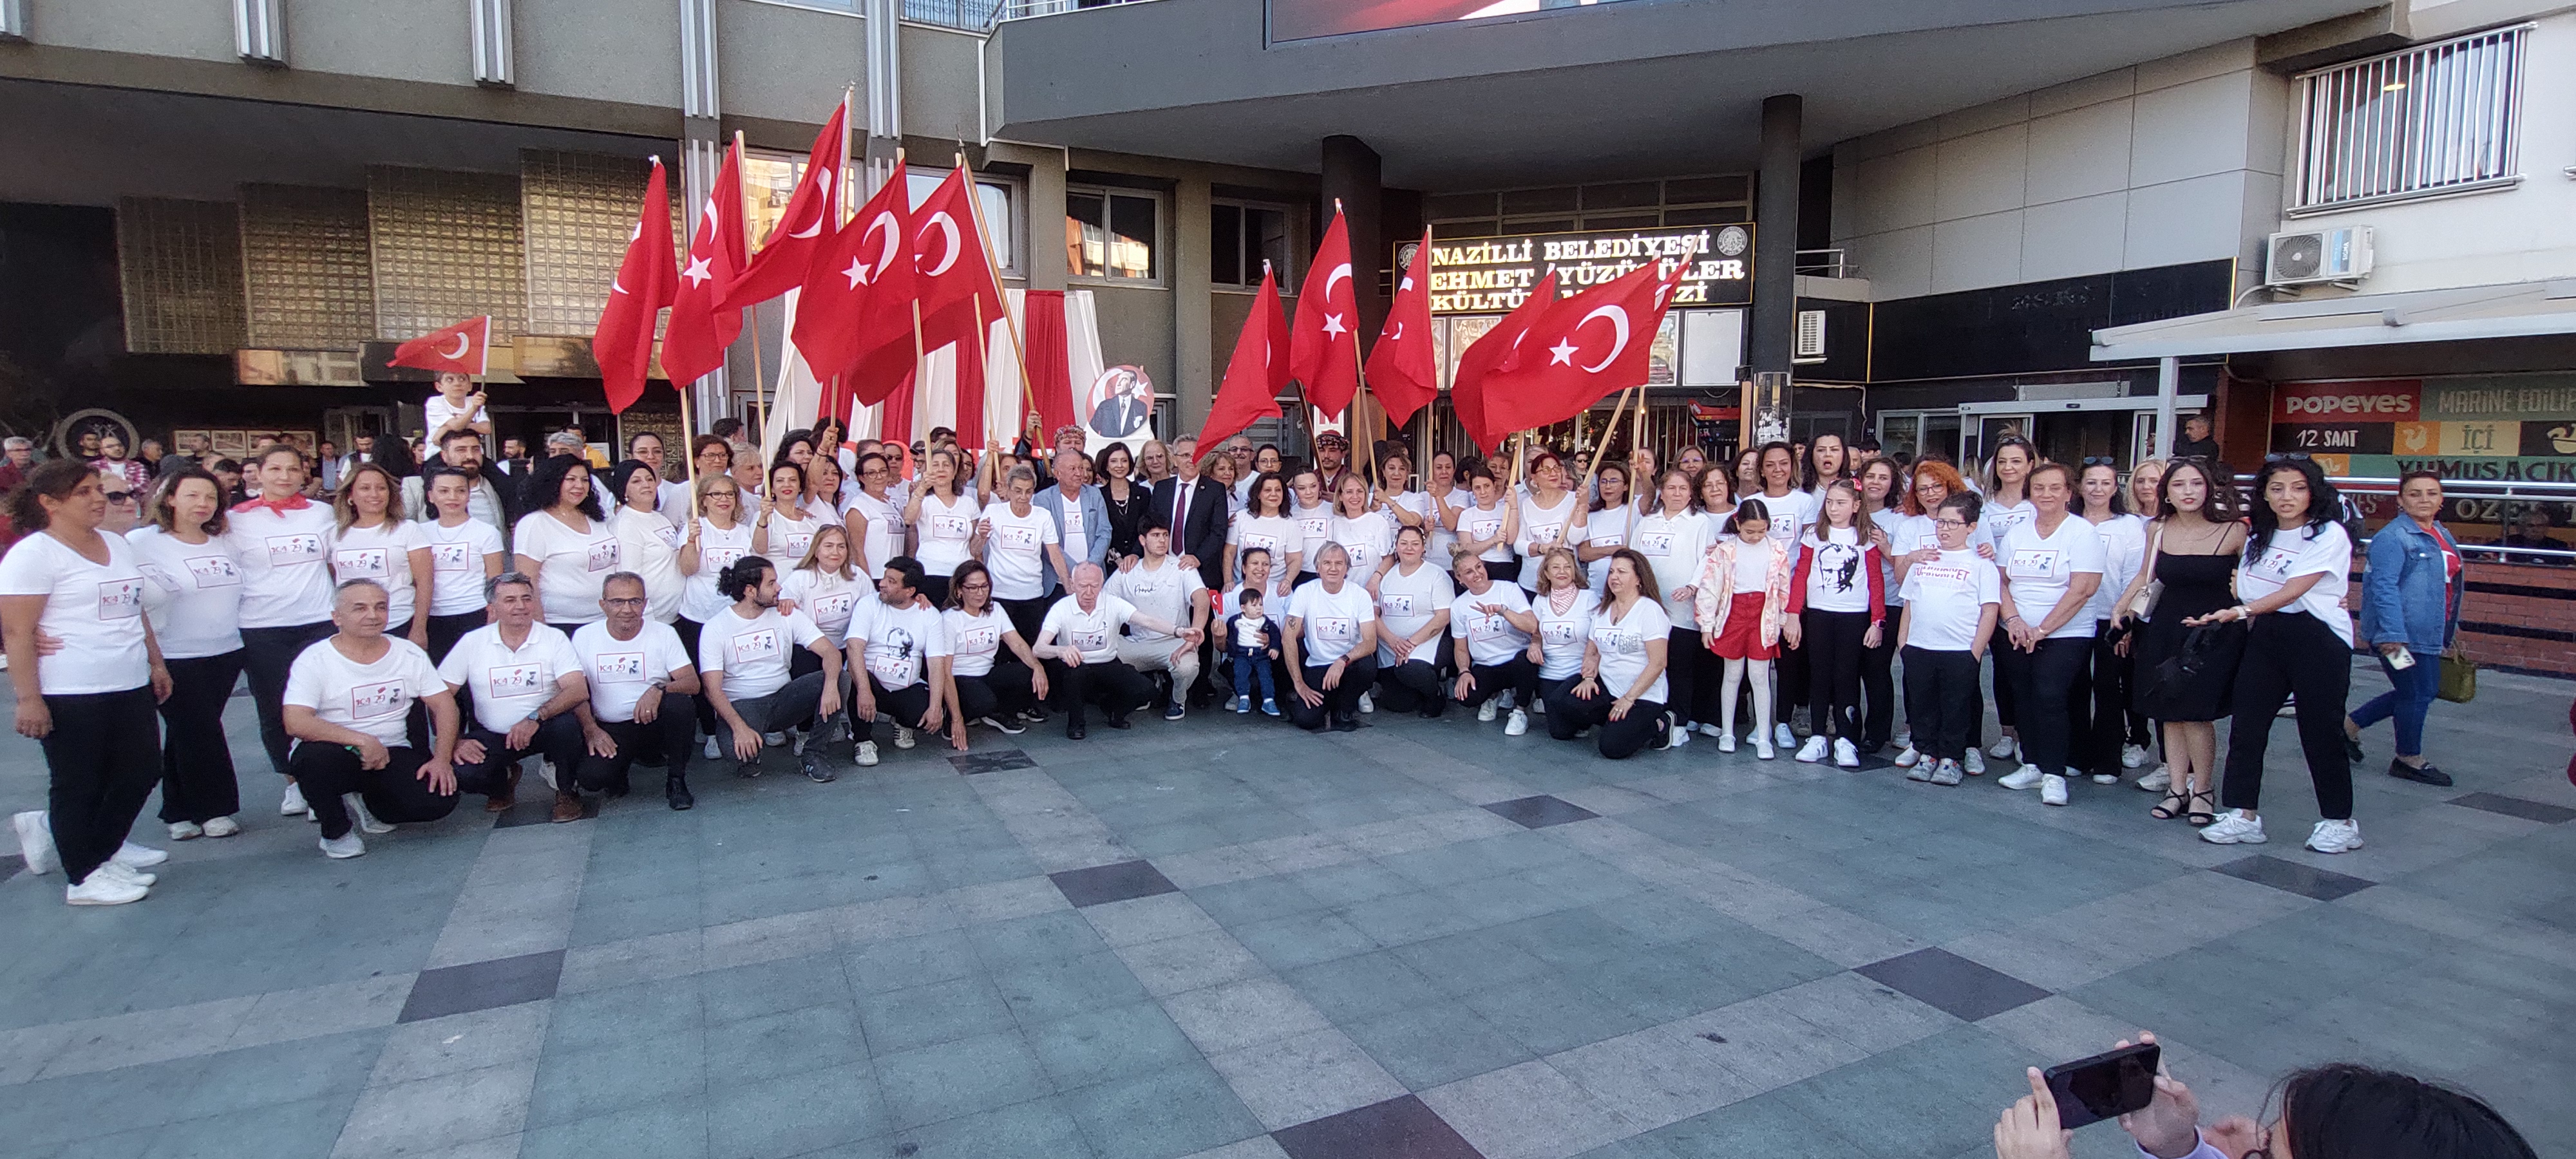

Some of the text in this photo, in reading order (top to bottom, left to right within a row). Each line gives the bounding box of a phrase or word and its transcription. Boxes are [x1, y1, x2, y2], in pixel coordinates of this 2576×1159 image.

[1432, 239, 1533, 266] NAZİLLİ
[1544, 230, 1710, 260] BELEDİYESİ
[1432, 268, 1535, 291] EHMET
[1432, 288, 1533, 310] KÜLTÜ
[2296, 429, 2359, 448] 12 SAAT
